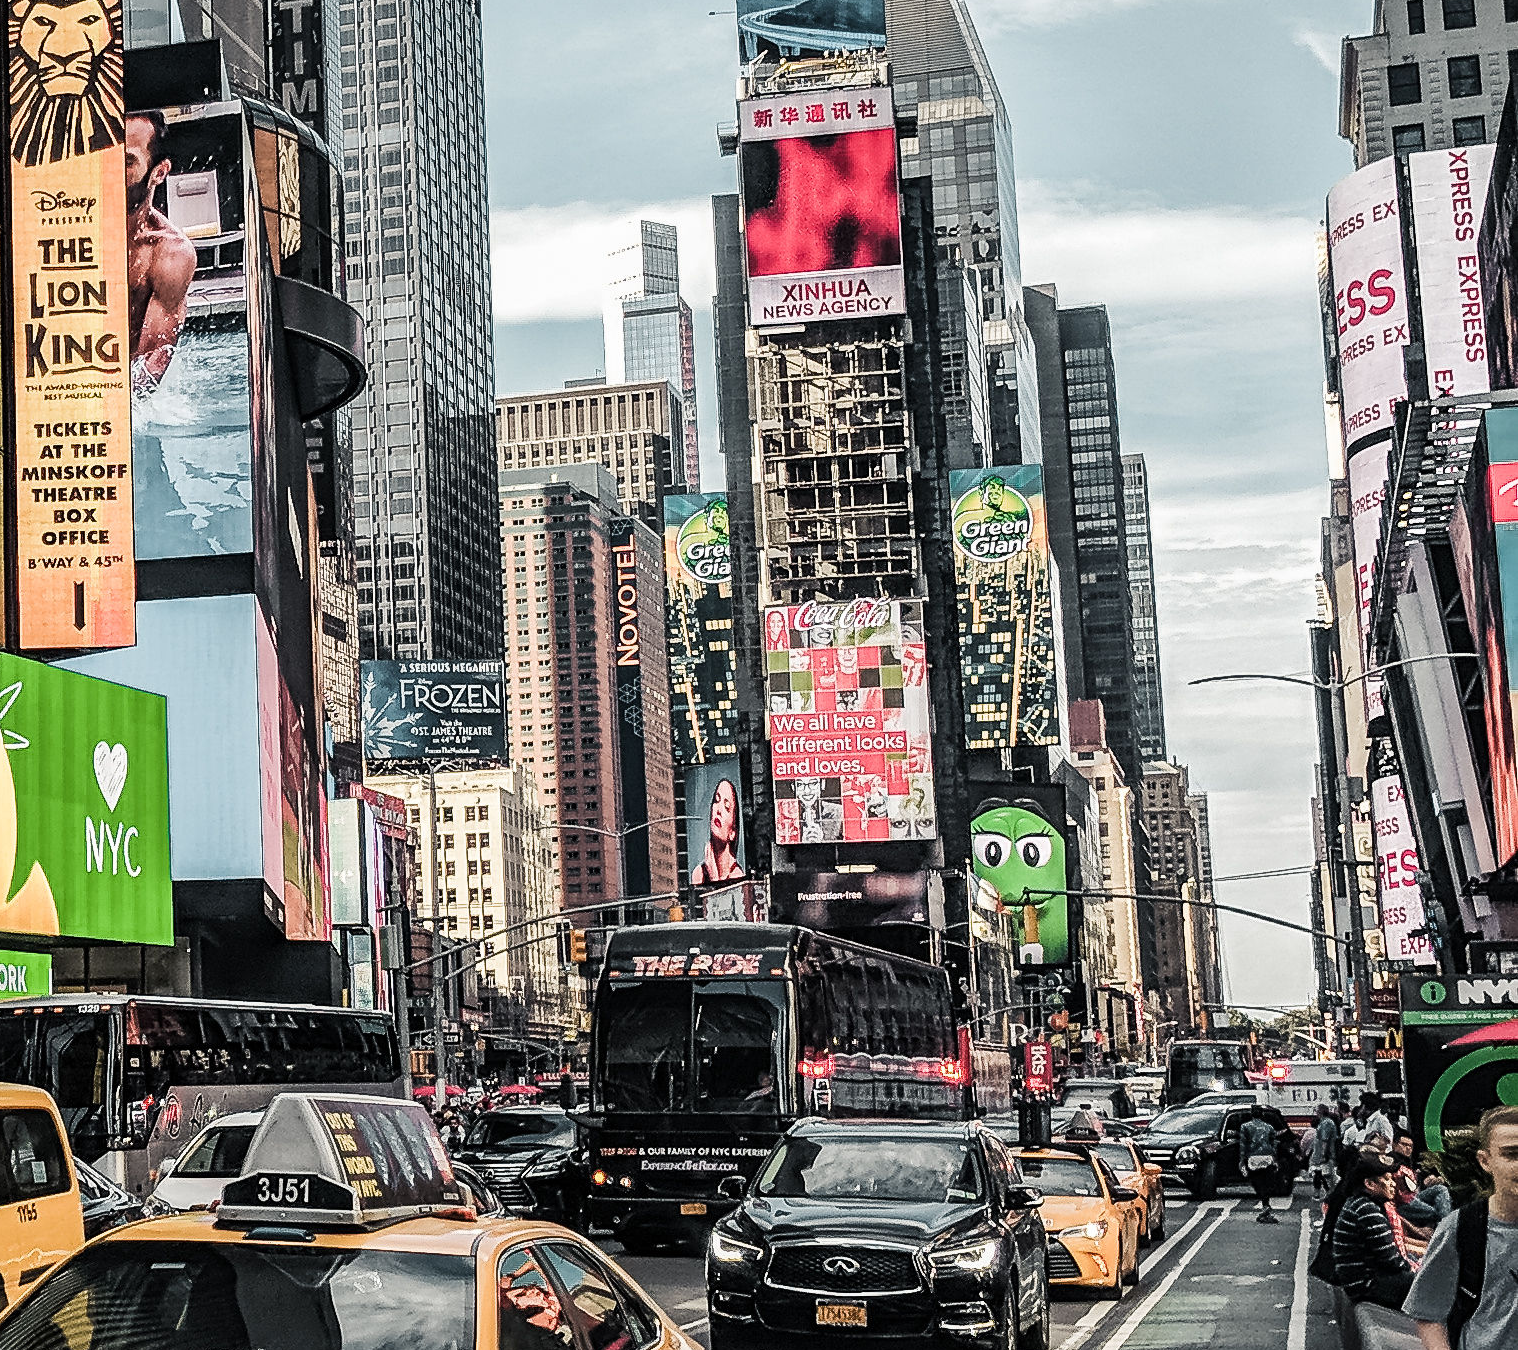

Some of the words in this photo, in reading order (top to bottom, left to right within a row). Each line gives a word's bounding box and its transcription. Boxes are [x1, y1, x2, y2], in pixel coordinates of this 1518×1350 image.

[753, 98, 879, 128] 新华通讯社
[31, 191, 96, 215] Disney
[38, 237, 94, 264] THE
[29, 273, 107, 319] LION
[783, 278, 871, 300] XINHUA
[763, 303, 814, 319] NEWS
[819, 295, 892, 315] AGENCY
[1457, 254, 1486, 362] EXPRESS
[25, 323, 121, 378] KING
[34, 421, 112, 438] TICKETS
[40, 445, 64, 459] AT
[71, 443, 107, 458] THE
[21, 464, 127, 481] MINSKOFF
[31, 486, 117, 502] THEATRE
[53, 508, 97, 523] BOX
[42, 530, 110, 545] OFFICE
[962, 520, 1030, 540] Green
[971, 536, 1031, 554] Giant
[79, 556, 89, 567] &
[617, 534, 641, 666] NOVOTEL
[409, 662, 450, 672] SERIOUS
[399, 679, 500, 713] FROZEN
[431, 727, 456, 736] JAMES
[458, 726, 492, 735] THEATRE
[774, 714, 804, 732] We
[808, 714, 829, 731] all
[833, 713, 875, 730] have
[774, 734, 852, 753] different
[856, 732, 905, 750] looks
[776, 758, 810, 775] and
[814, 756, 865, 776] loves,
[85, 815, 142, 878] NYC
[632, 955, 687, 976] THE
[690, 953, 763, 976] RIDE
[1031, 1045, 1047, 1075] tkts
[325, 1112, 342, 1129] OUT
[639, 1147, 646, 1156] &
[648, 1147, 666, 1156] OUR
[668, 1147, 696, 1156] FAMILY
[698, 1147, 710, 1156] OF
[712, 1147, 730, 1156] NYC
[343, 1155, 376, 1174] WORLD
[257, 1177, 310, 1203] 3J51
[17, 1203, 38, 1224] 1Y65
